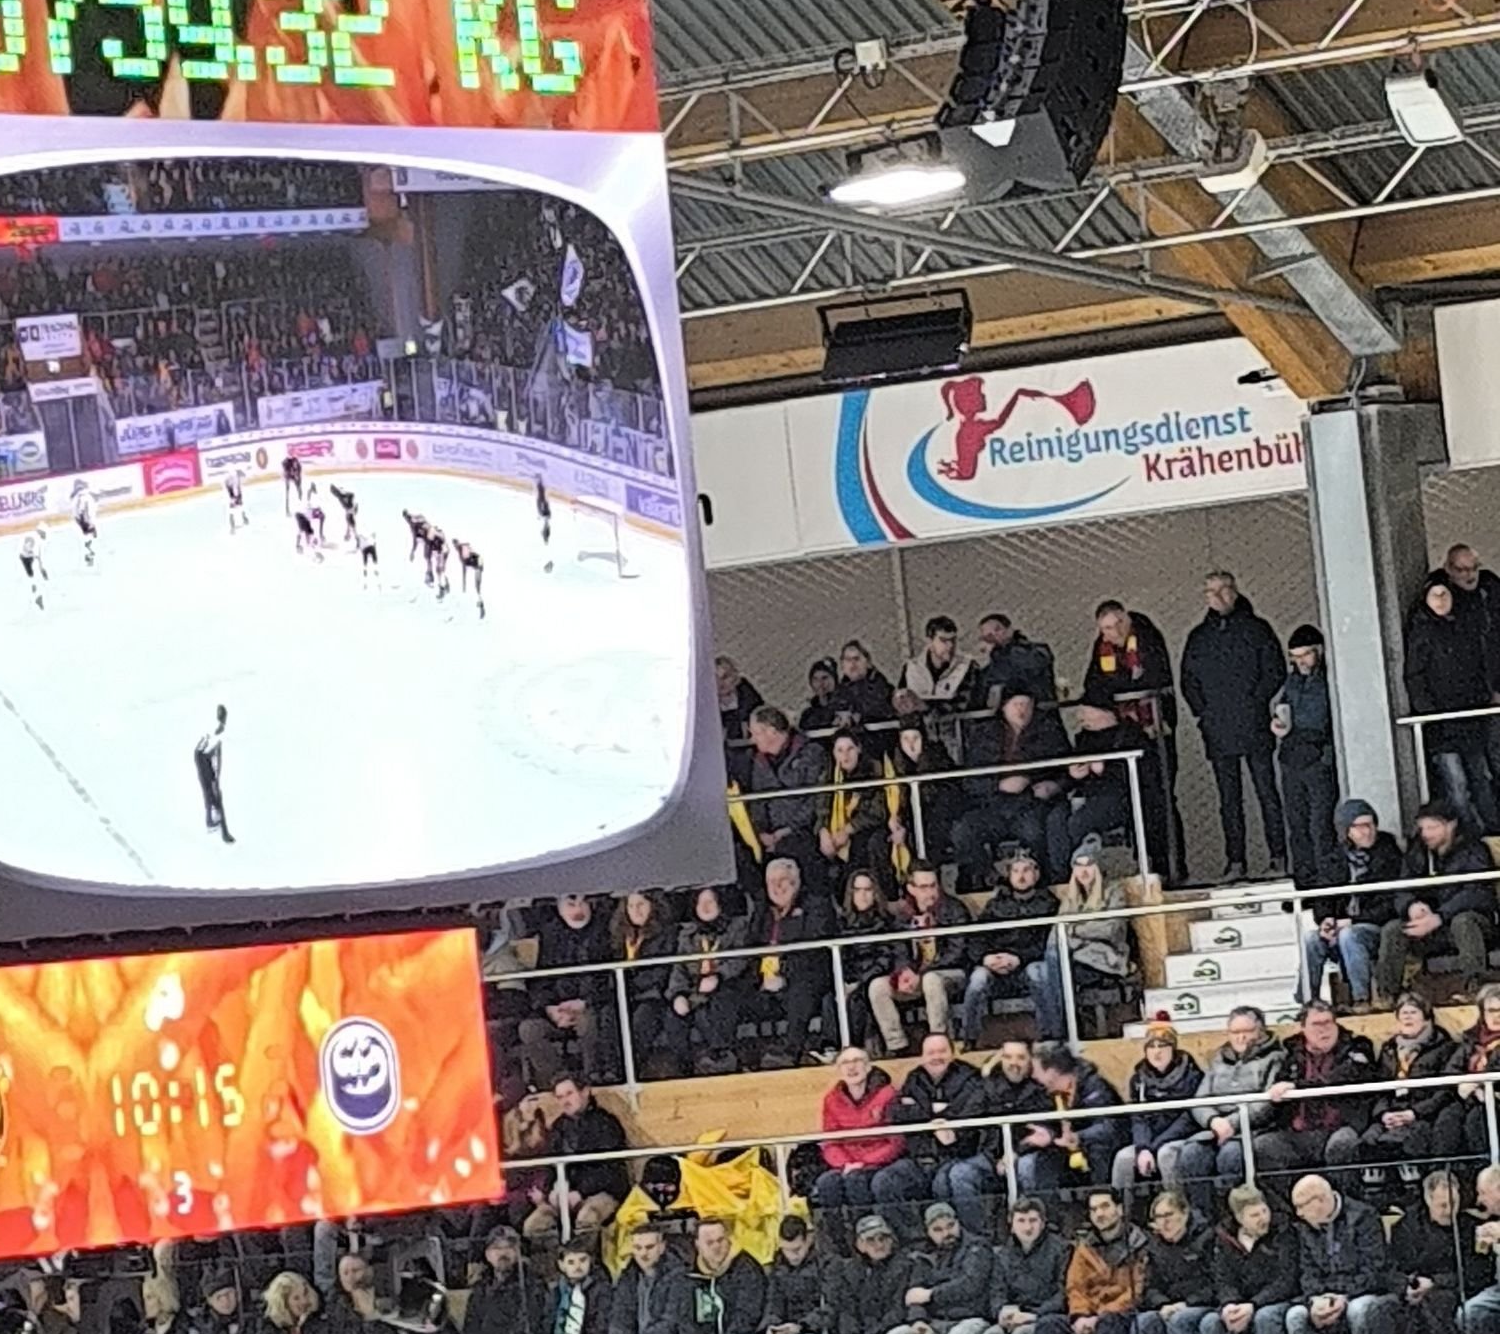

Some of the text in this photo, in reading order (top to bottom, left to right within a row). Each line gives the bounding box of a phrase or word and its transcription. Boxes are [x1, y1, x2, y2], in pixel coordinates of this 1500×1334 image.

[989, 405, 1252, 468] Reinigungsdienst
[112, 1063, 245, 1137] 10:15
[175, 1169, 193, 1214] 3
